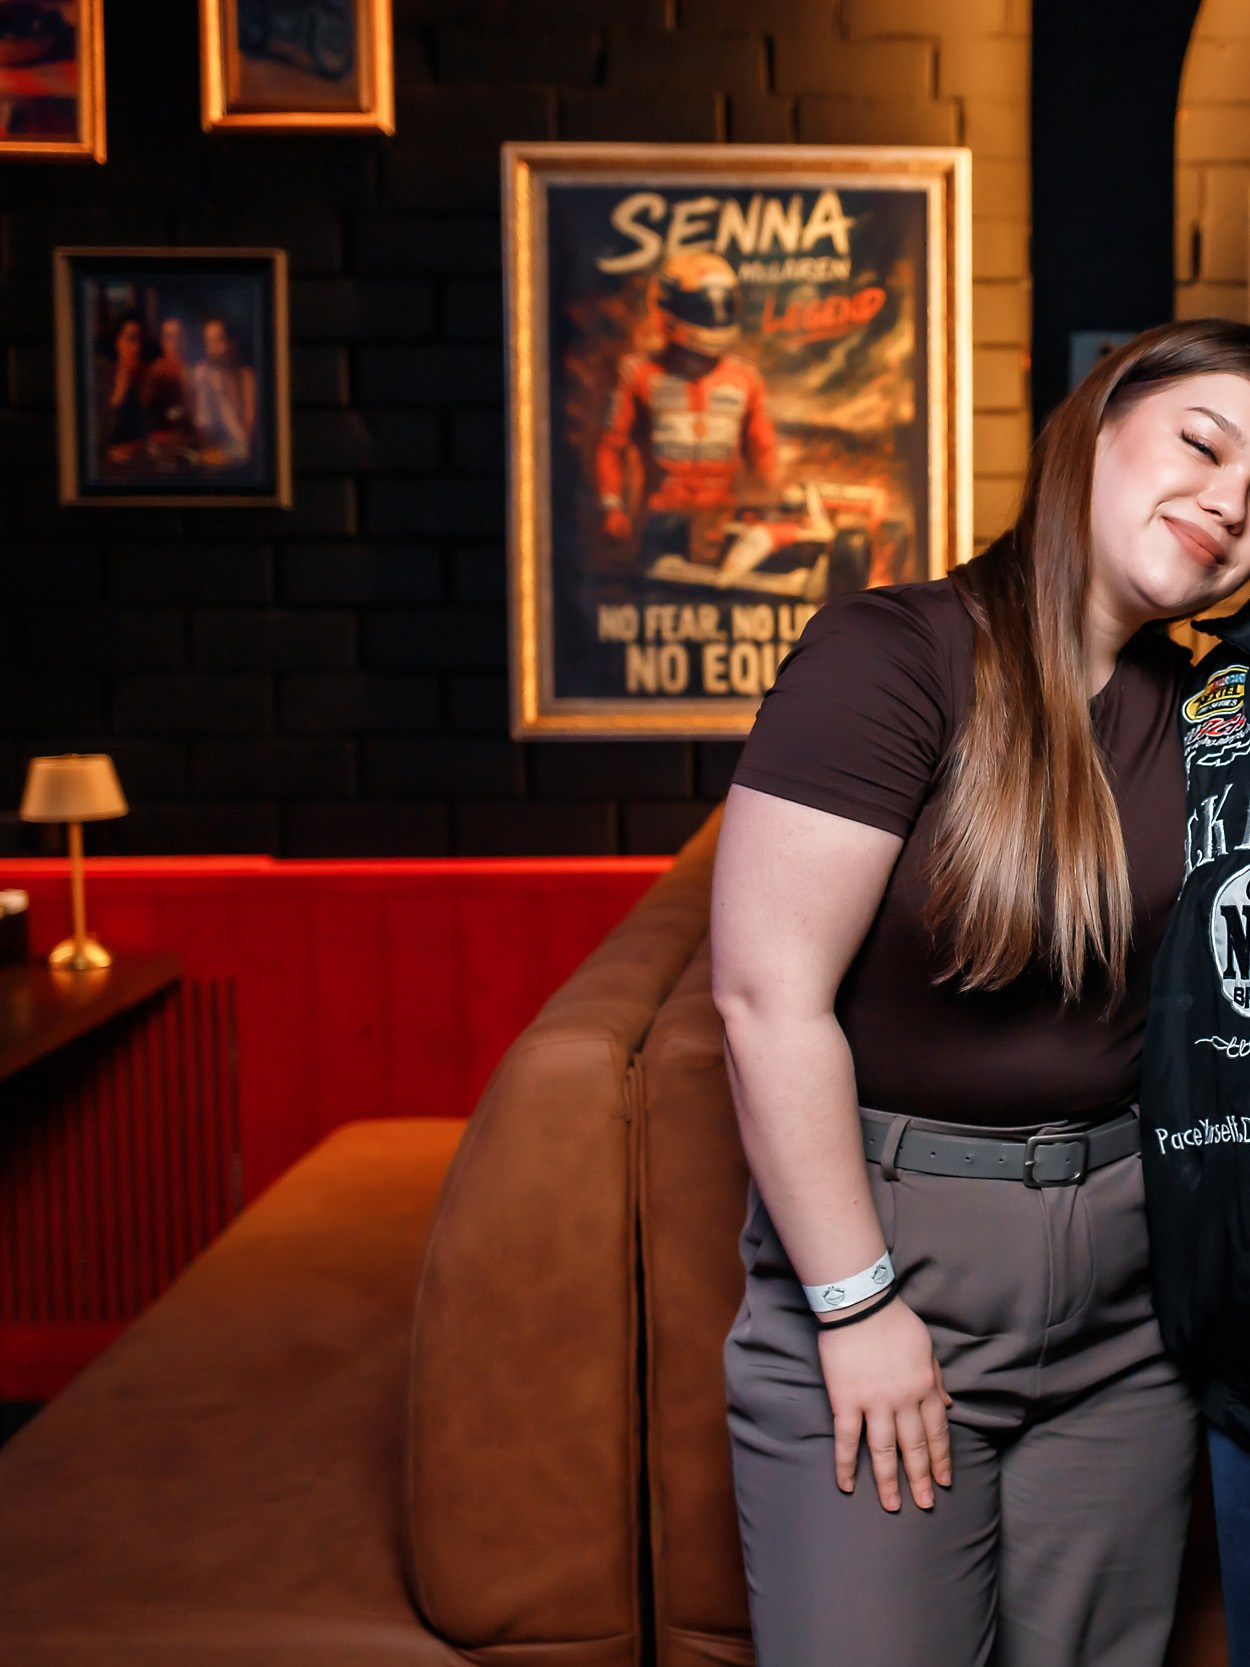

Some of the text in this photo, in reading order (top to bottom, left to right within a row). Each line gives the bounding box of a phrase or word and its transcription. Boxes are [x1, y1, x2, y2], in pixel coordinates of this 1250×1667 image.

[599, 188, 855, 275] SENNA
[598, 603, 640, 643] NO
[732, 602, 775, 643] NO
[626, 642, 690, 695] NO
[1155, 1127, 1203, 1155] Pace
